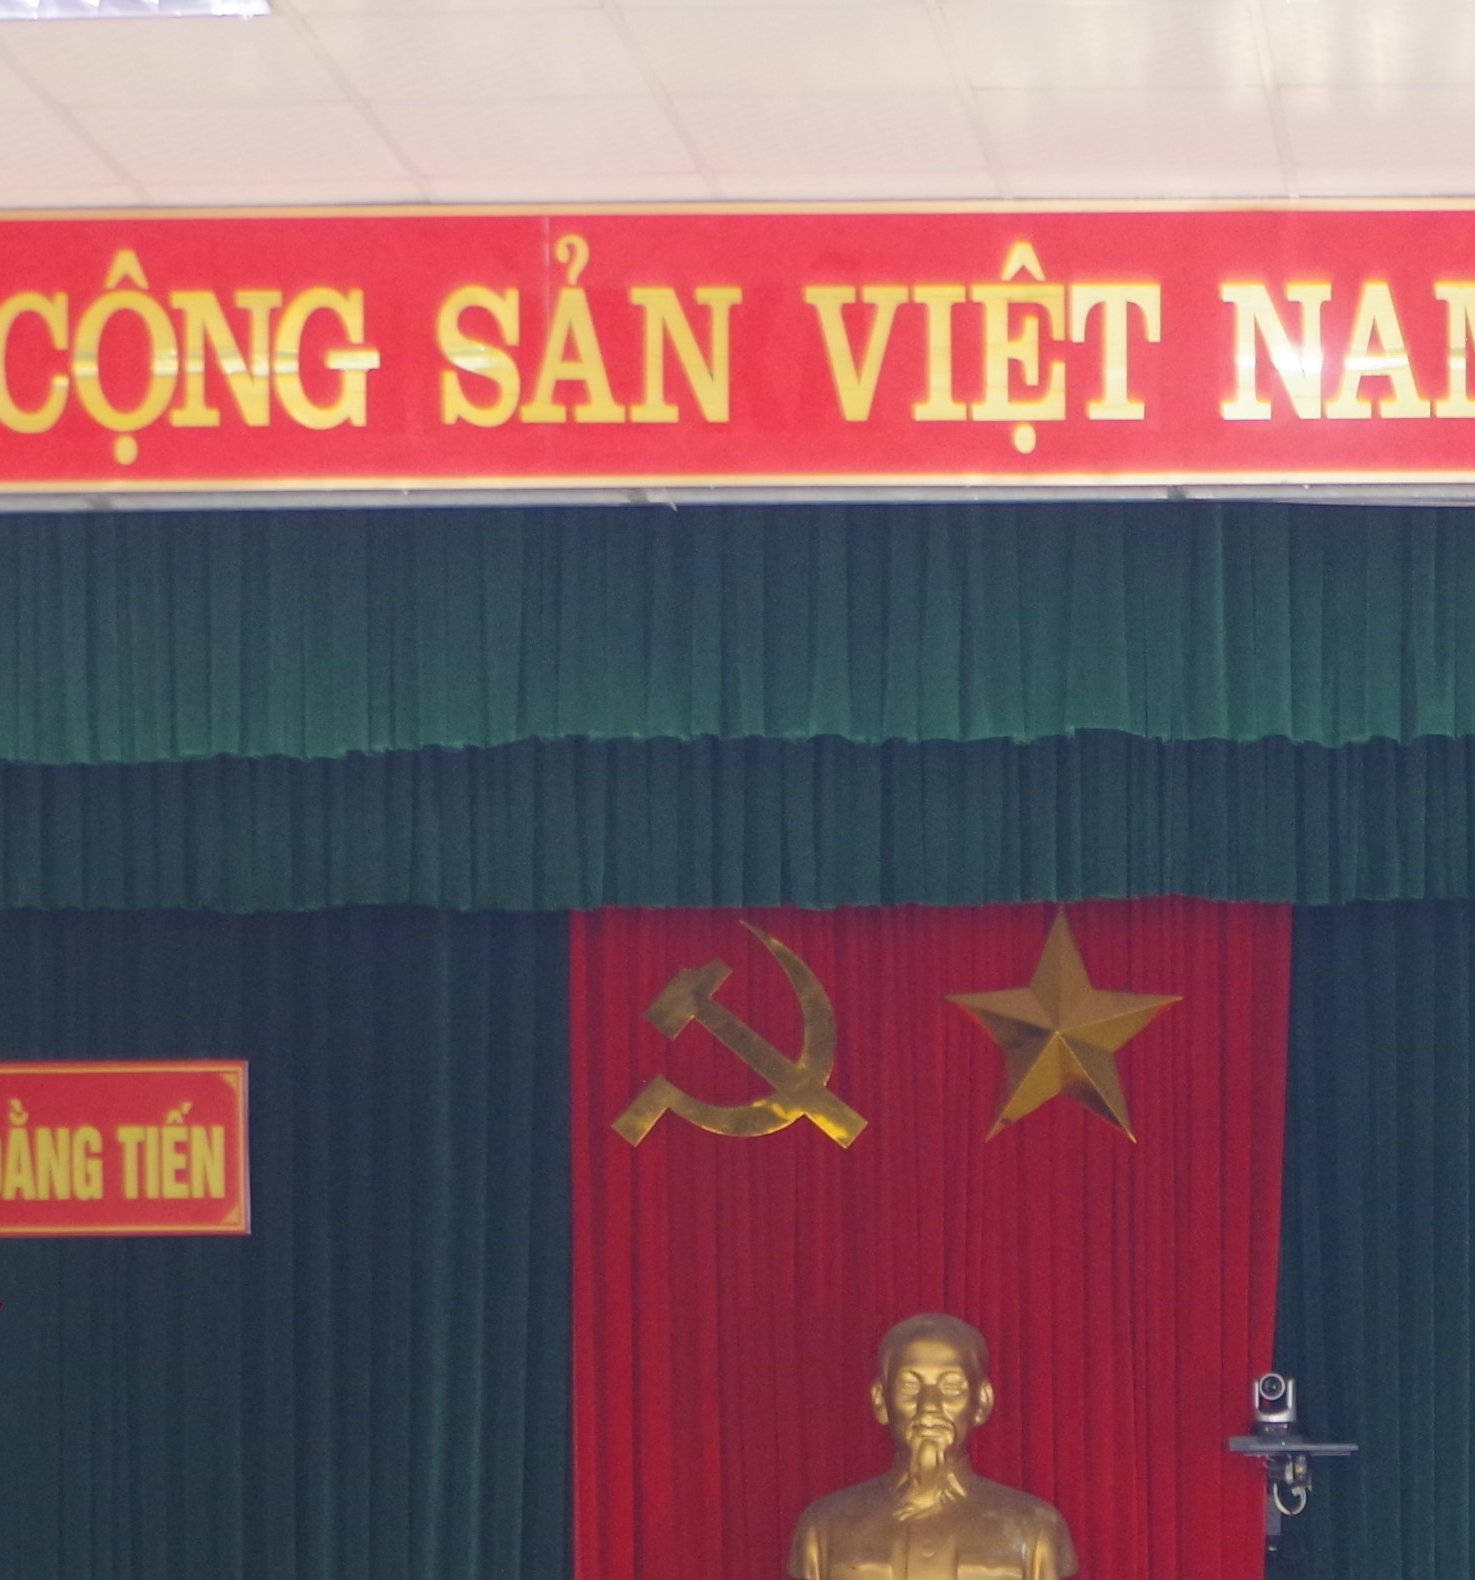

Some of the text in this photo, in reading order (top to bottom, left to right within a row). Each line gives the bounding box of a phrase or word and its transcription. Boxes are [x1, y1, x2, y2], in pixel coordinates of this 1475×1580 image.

[437, 234, 742, 428] SẢN
[804, 242, 1162, 454] VIỆT
[116, 1101, 225, 1200] TIẾN
